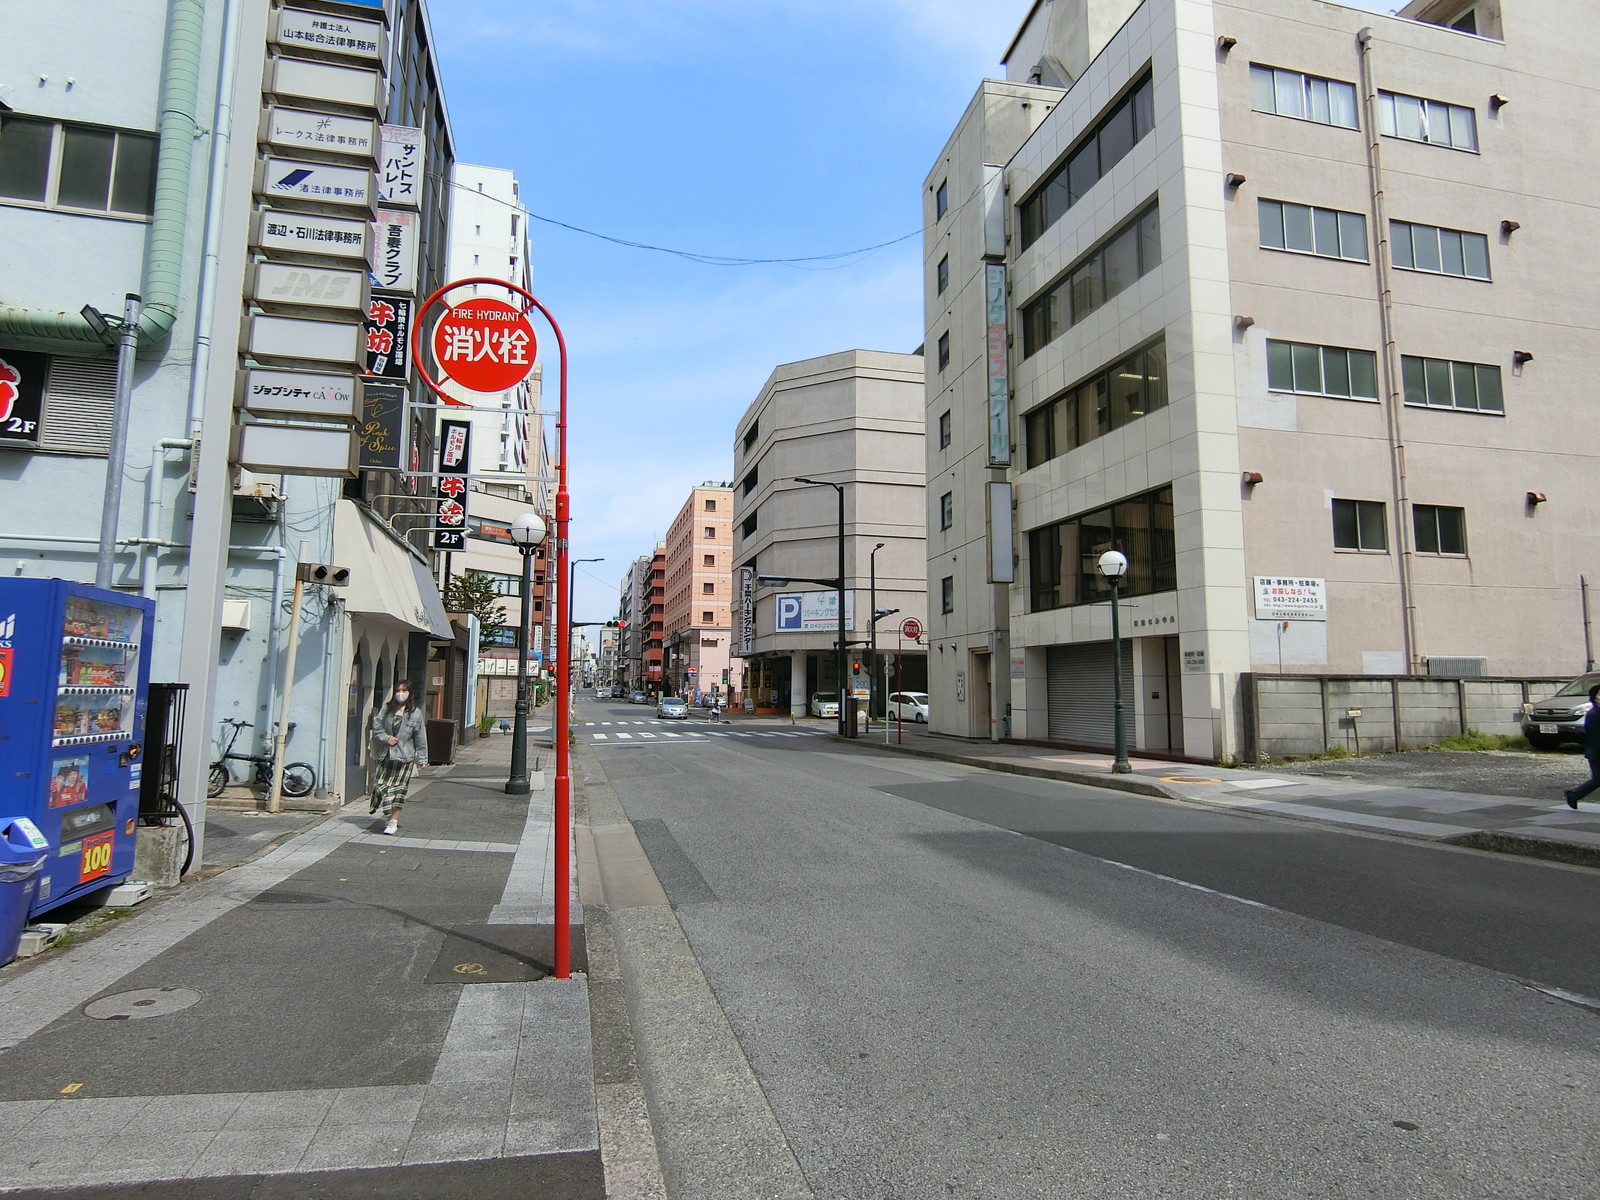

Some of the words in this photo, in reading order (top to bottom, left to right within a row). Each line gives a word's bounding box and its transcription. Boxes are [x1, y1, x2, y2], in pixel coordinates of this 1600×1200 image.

[312, 20, 351, 34] 弁護士法人
[283, 28, 377, 52] 山本総合法律事務所
[276, 127, 368, 147] レークス法律事務所
[386, 158, 402, 199] バレー
[400, 144, 416, 195] サントス
[267, 223, 362, 245] 渡辺・石川法律事務所
[384, 224, 403, 286] 吾妻クラブ
[271, 271, 352, 300] JMS
[452, 308, 474, 320] FIRE
[476, 309, 520, 322] HYDRANT
[444, 325, 530, 365] 消火栓
[253, 385, 311, 398] ジョブシティ
[7, 417, 37, 434] 2F
[368, 436, 397, 453] Spice
[440, 532, 460, 544] 2F
[1273, 596, 1318, 604] 043-224-2455
[780, 598, 799, 628] P
[803, 608, 850, 617] パーキングセンー
